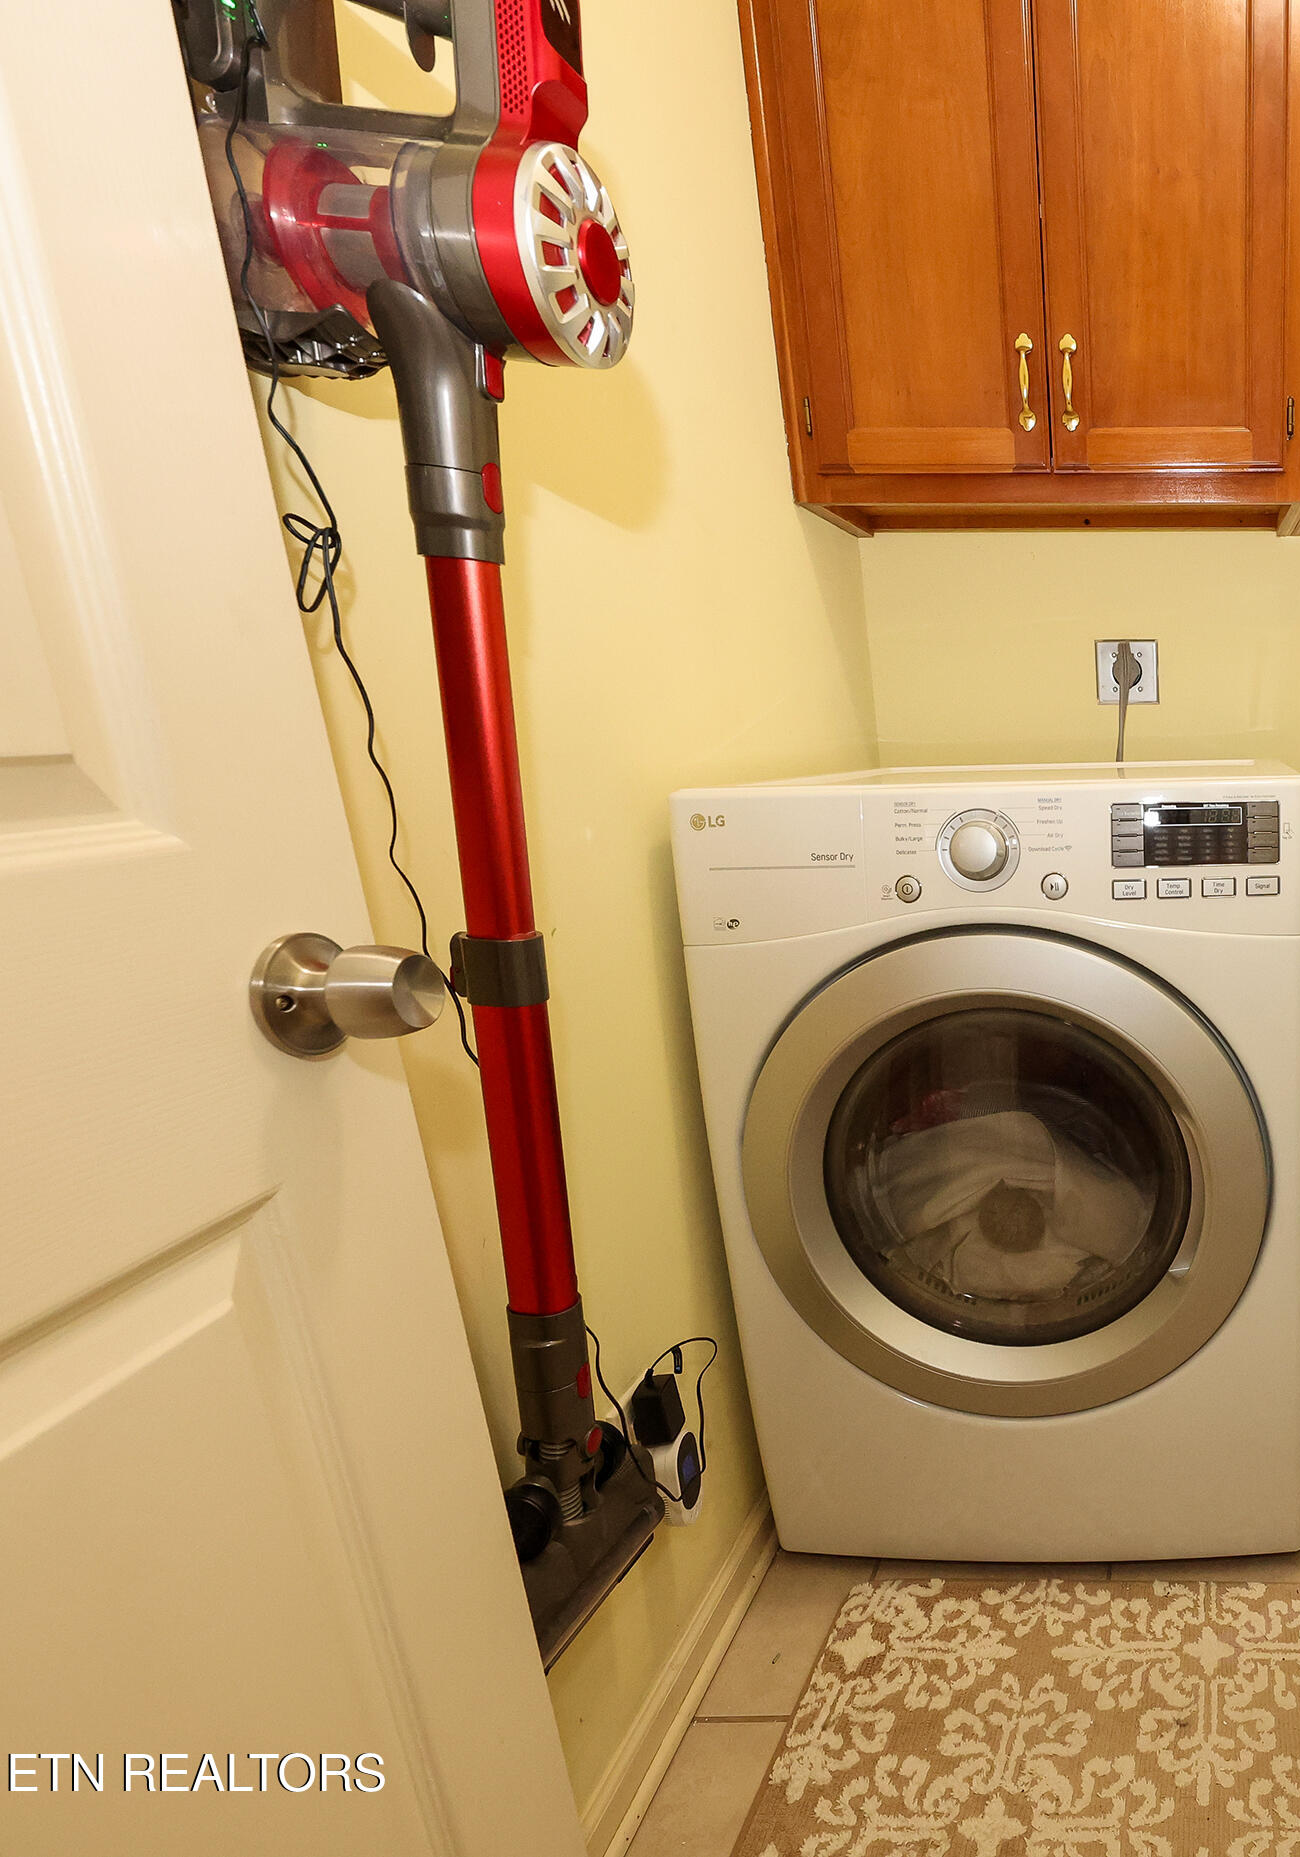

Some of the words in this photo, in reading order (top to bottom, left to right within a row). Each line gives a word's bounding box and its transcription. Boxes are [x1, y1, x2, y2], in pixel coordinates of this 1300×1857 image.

[708, 815, 726, 828] LG
[811, 853, 838, 862] Sensor
[839, 852, 854, 862] Dry
